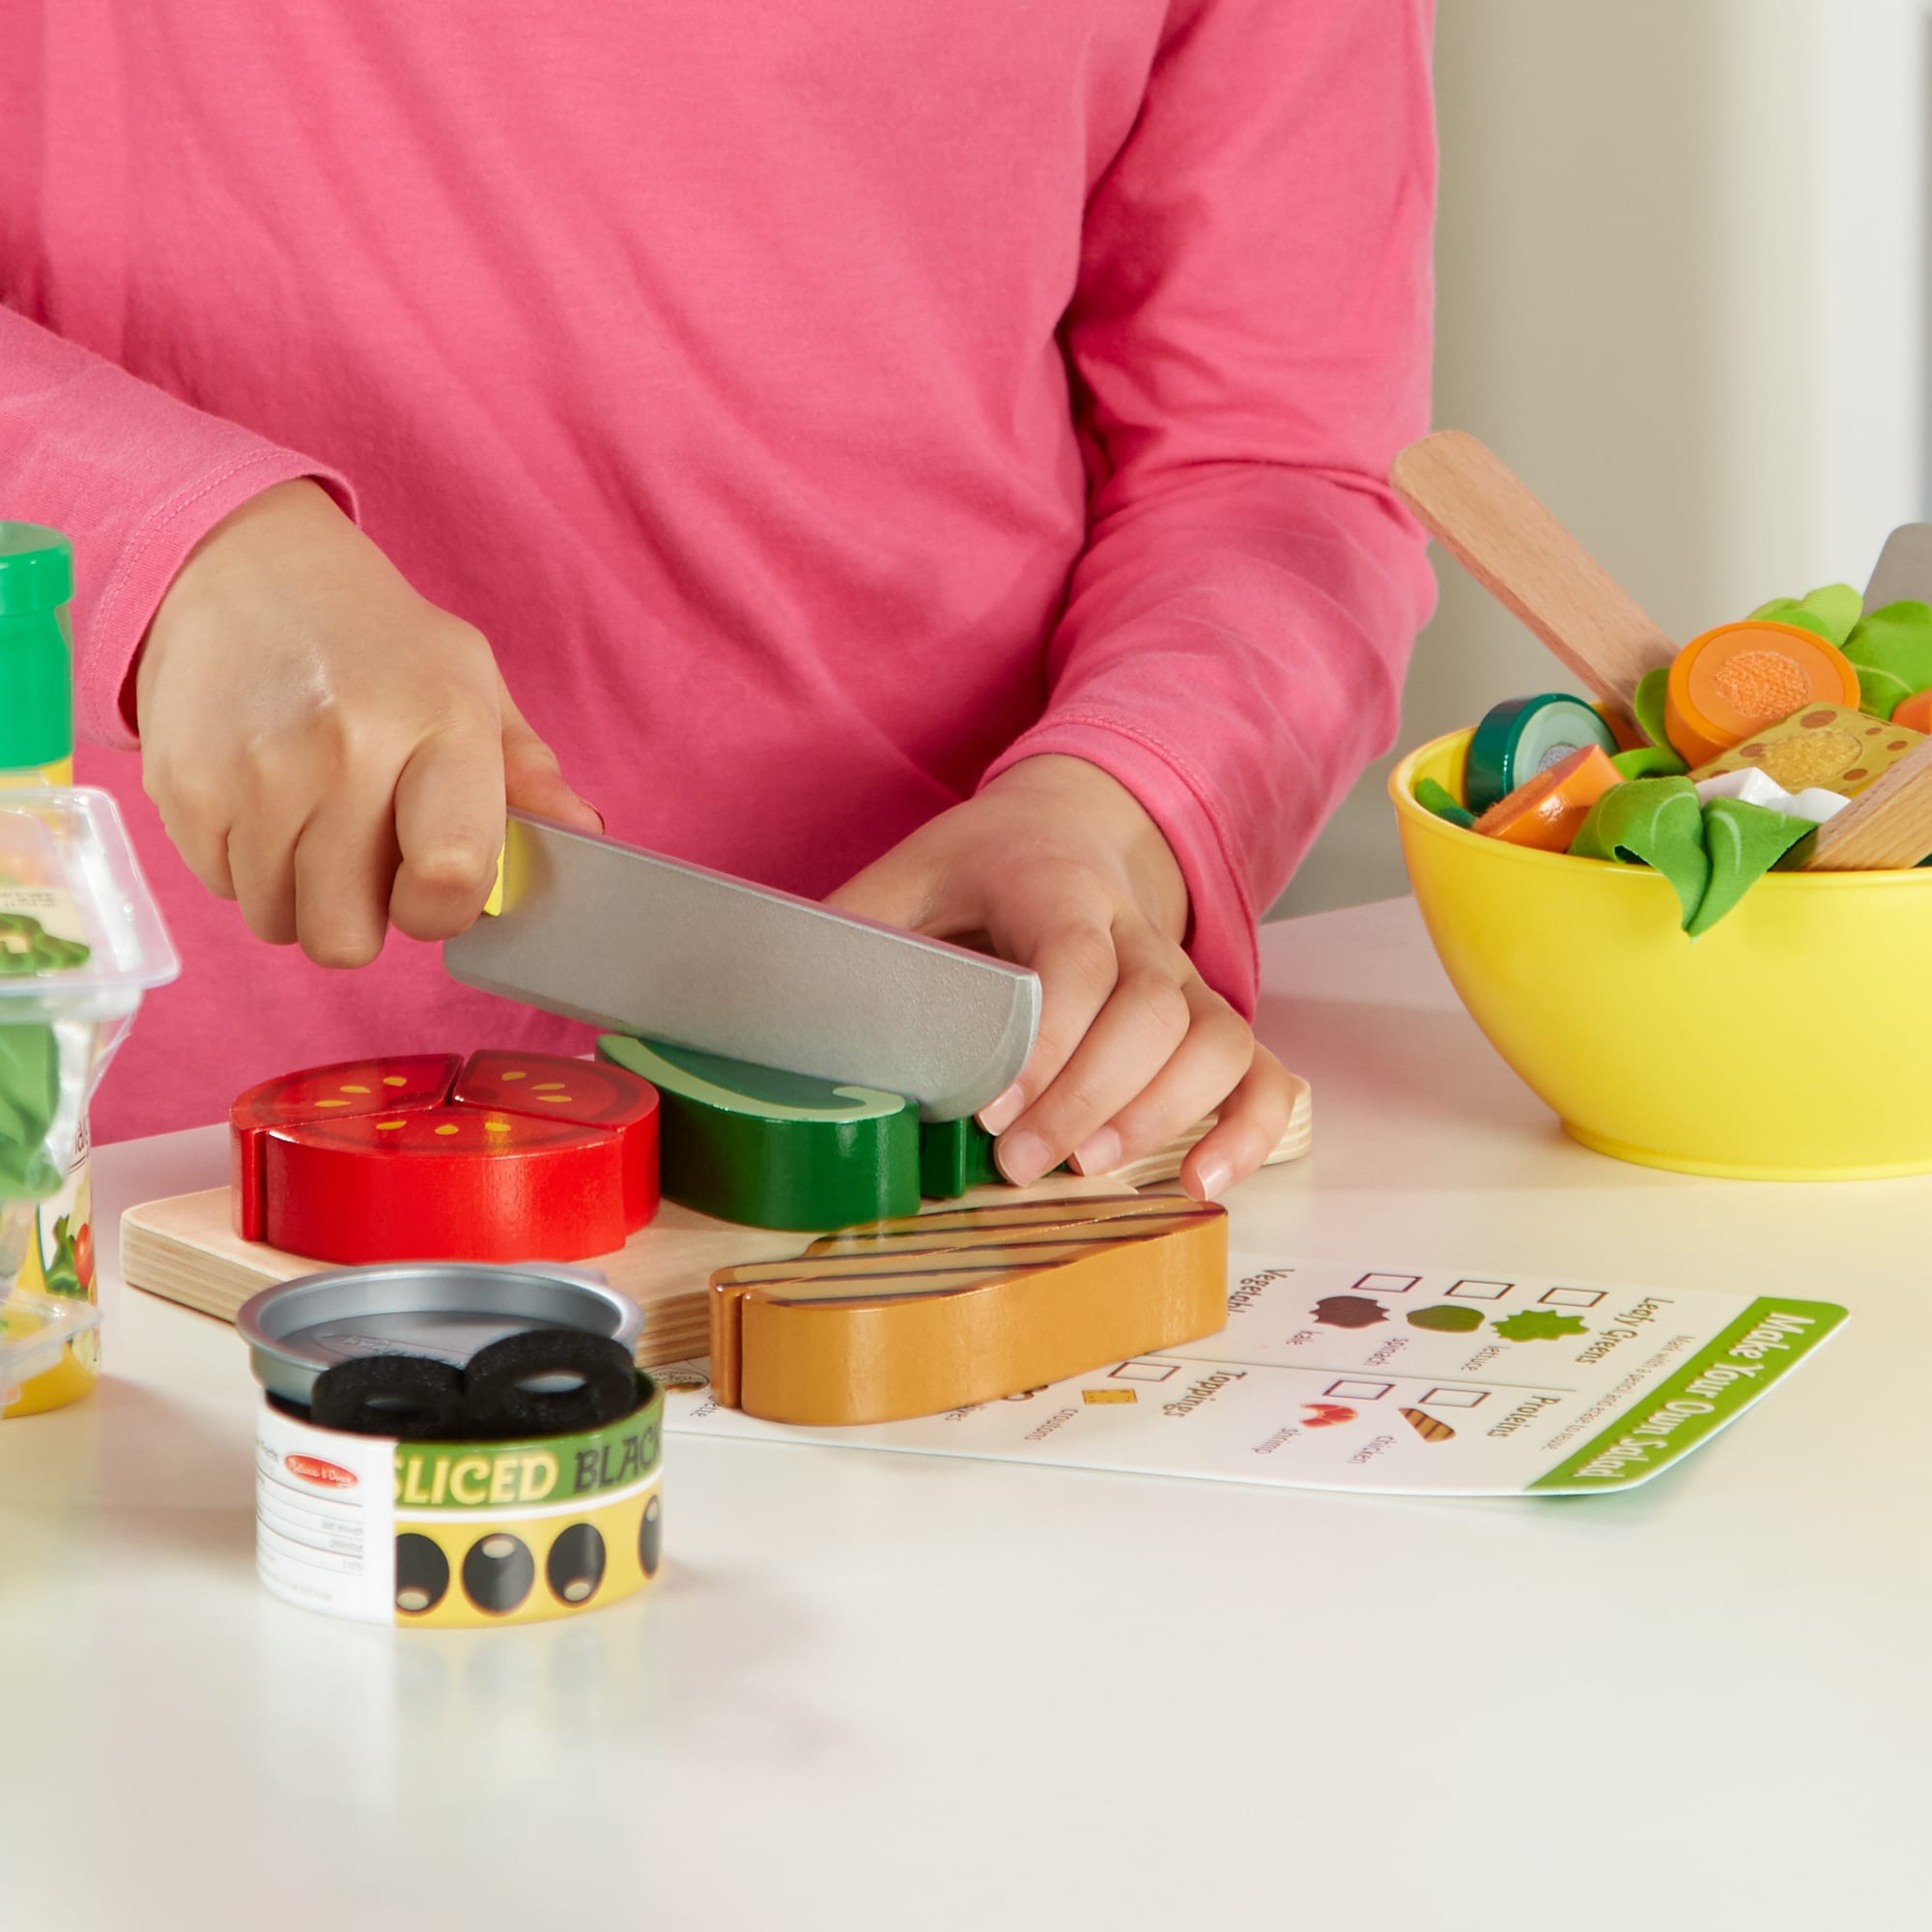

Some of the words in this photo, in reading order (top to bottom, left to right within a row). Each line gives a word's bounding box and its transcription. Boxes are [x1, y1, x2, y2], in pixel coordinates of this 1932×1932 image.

[1227, 1267, 1296, 1316] Vegetabl
[1613, 1296, 1675, 1326] Leafy
[1363, 1337, 1409, 1367] spinach
[1576, 1328, 1638, 1364] Greens
[1727, 1311, 1816, 1359] Make
[1460, 1345, 1512, 1372] lettuce
[1162, 1371, 1249, 1419] Toppings
[1684, 1362, 1765, 1398] Your
[1024, 1407, 1079, 1441] croutons
[1486, 1394, 1562, 1439] Proteins
[1632, 1400, 1716, 1435] Own
[1252, 1427, 1302, 1456] shrimp
[1347, 1435, 1399, 1464] chicken
[1573, 1436, 1668, 1478] Salad
